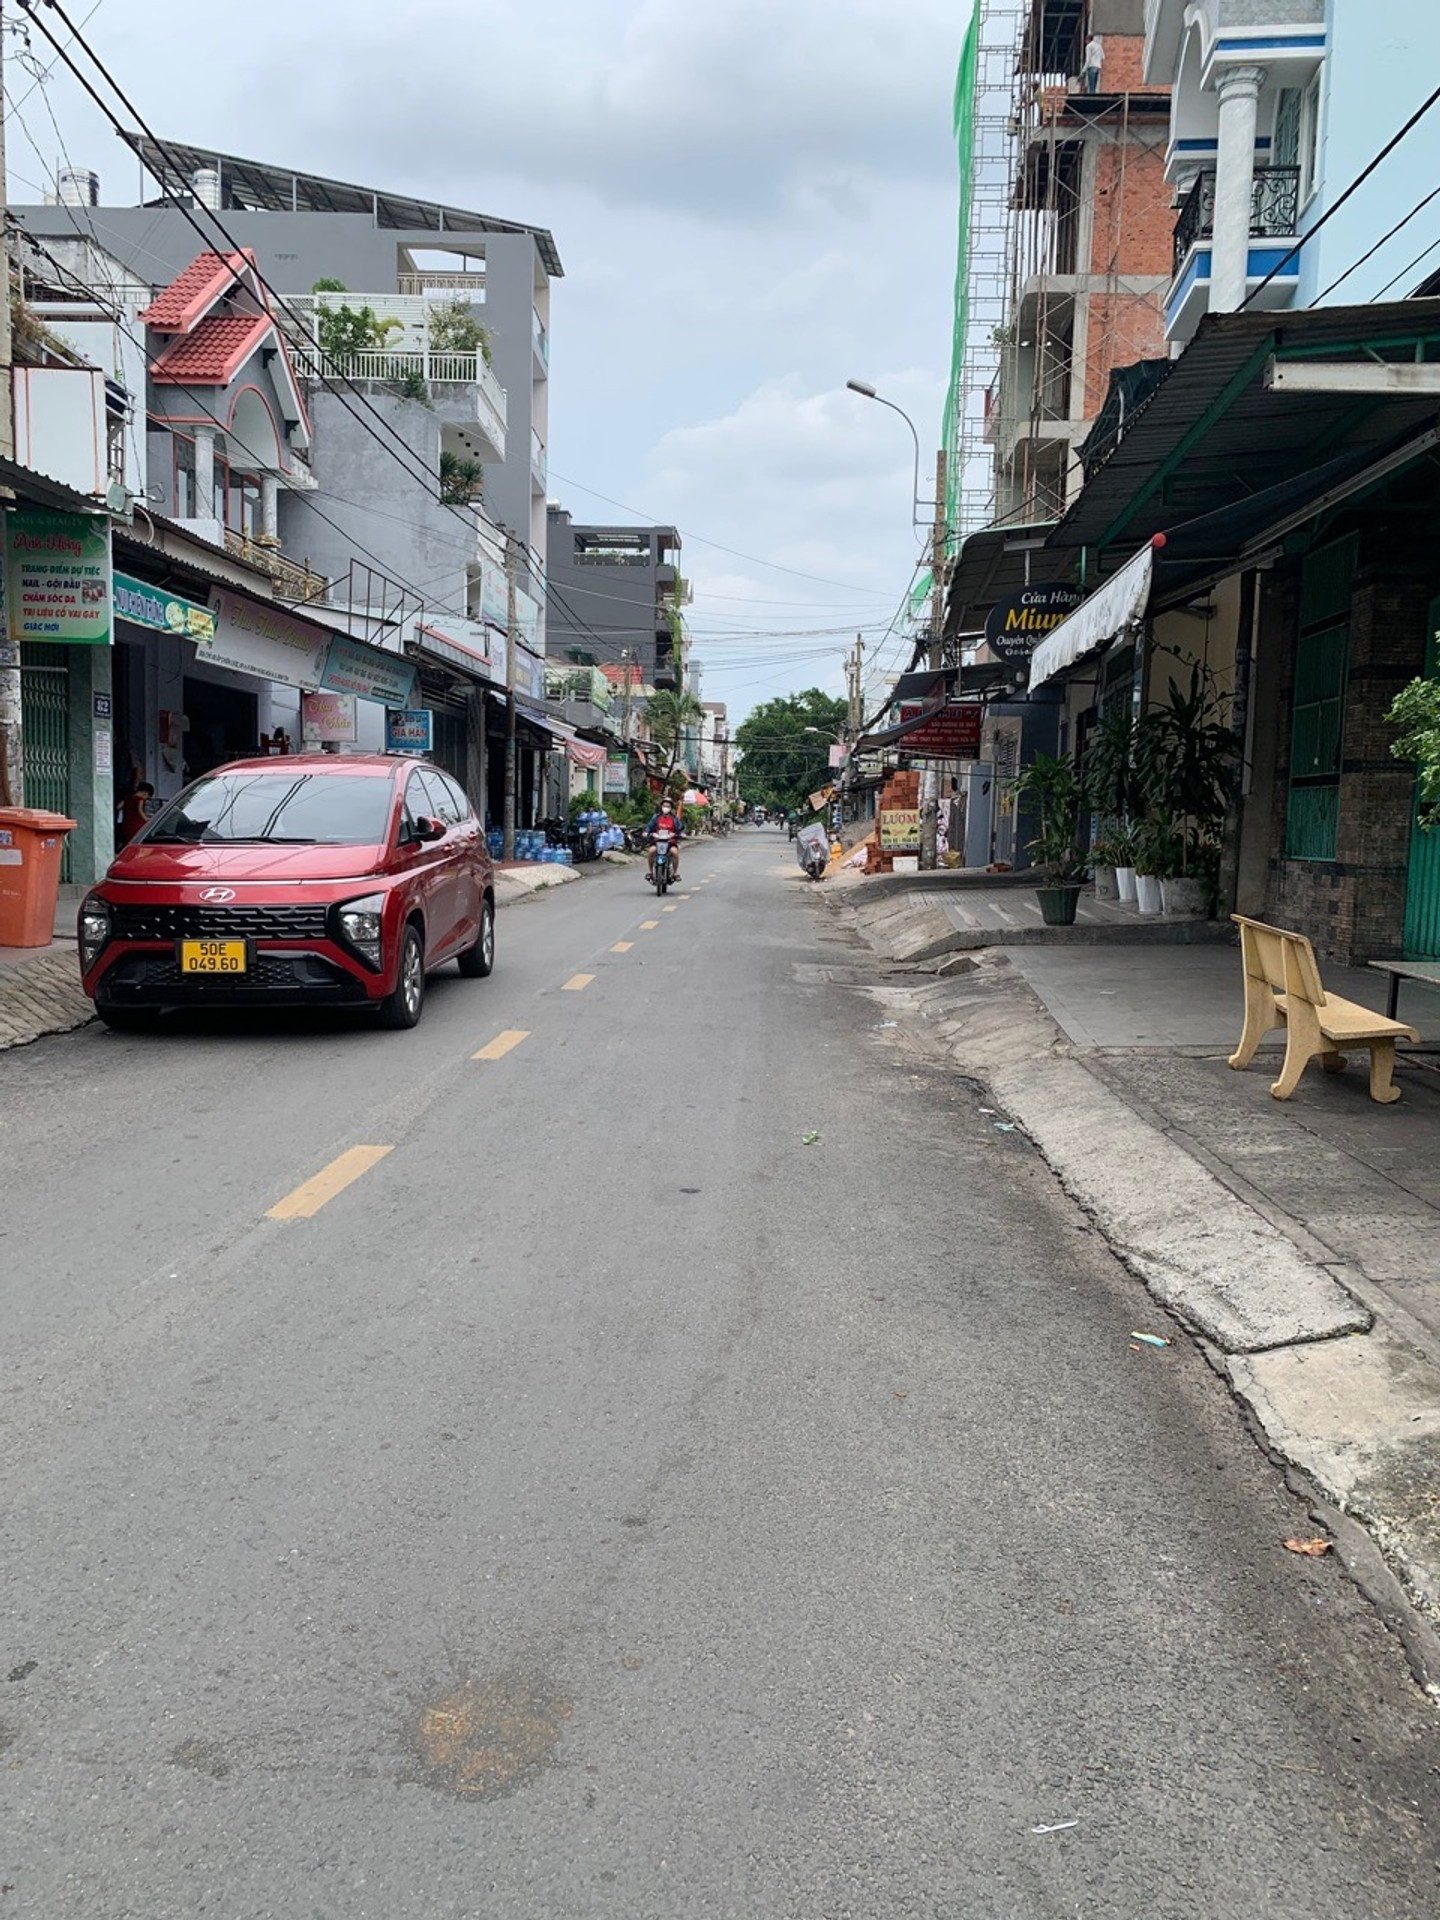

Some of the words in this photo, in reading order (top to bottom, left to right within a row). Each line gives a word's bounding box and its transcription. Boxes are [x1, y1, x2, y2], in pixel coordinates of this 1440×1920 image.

[21, 564, 48, 574] TRANG
[22, 579, 40, 588] NAIL
[65, 595, 77, 604] DA
[200, 943, 227, 956] 50E
[189, 957, 239, 971] 049.60
